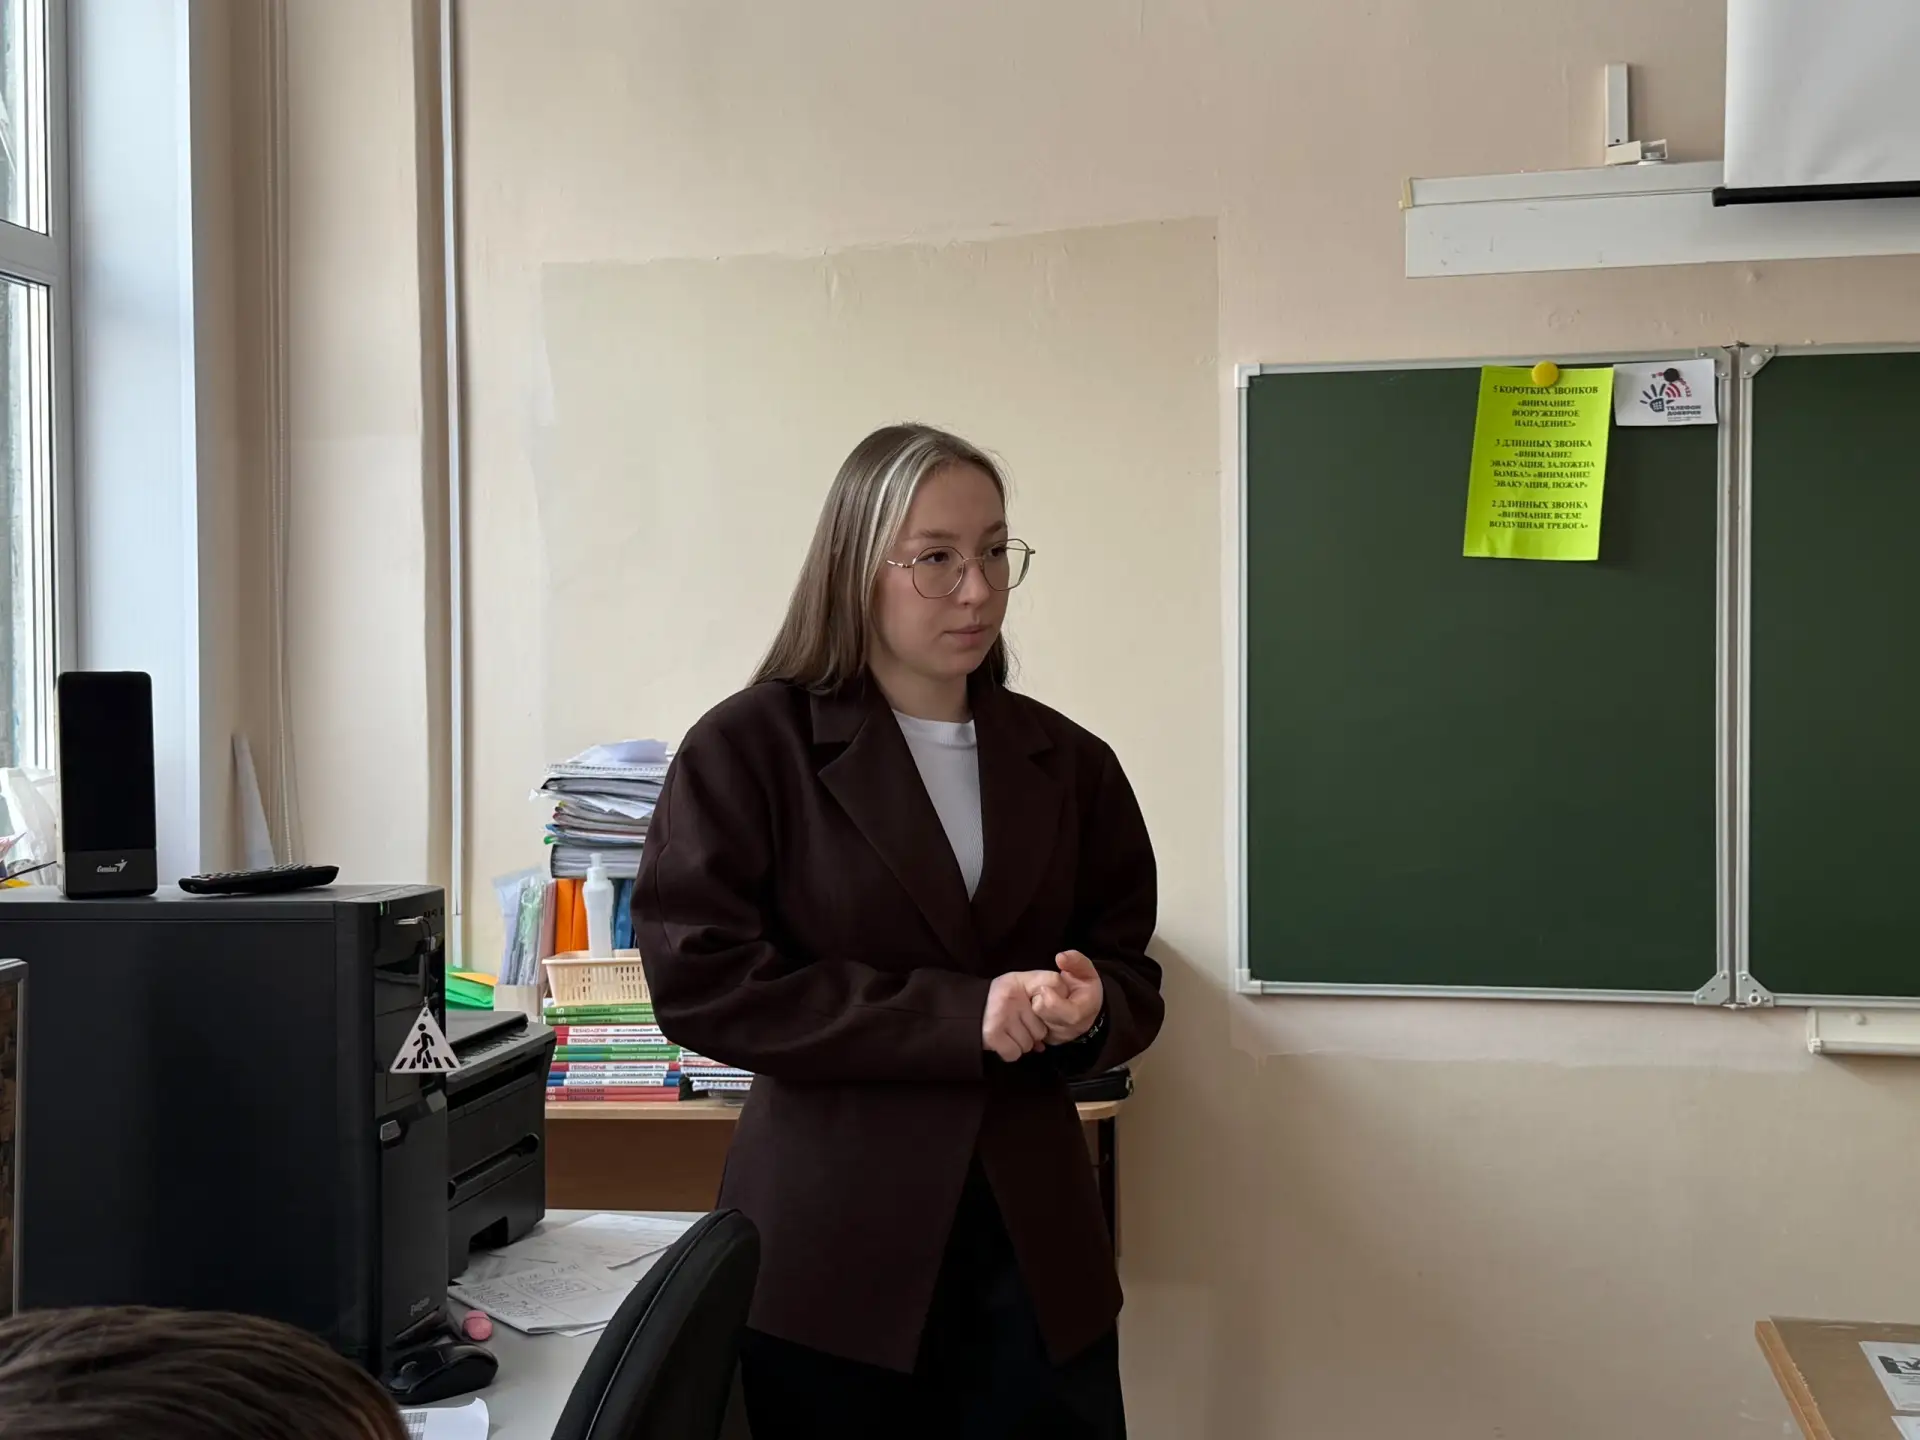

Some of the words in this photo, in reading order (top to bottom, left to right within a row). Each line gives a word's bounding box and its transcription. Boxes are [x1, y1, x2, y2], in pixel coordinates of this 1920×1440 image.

[1500, 386, 1550, 395] КОРОТКИХ
[1554, 386, 1598, 395] ЗВОНКОВ
[1512, 409, 1580, 418] ВООРУЖЕННОЕ
[1502, 439, 1552, 448] ДЛИННЫХ
[1555, 440, 1592, 448] ЗВОНКА
[1548, 460, 1595, 469] ЗАЛОЖЕНА
[1491, 500, 1497, 508] 2
[1498, 500, 1549, 509] ДЛИННЫХ
[1551, 501, 1588, 509] ЗВОНКА
[1489, 520, 1545, 530] ВОЗДУШНАЯ
